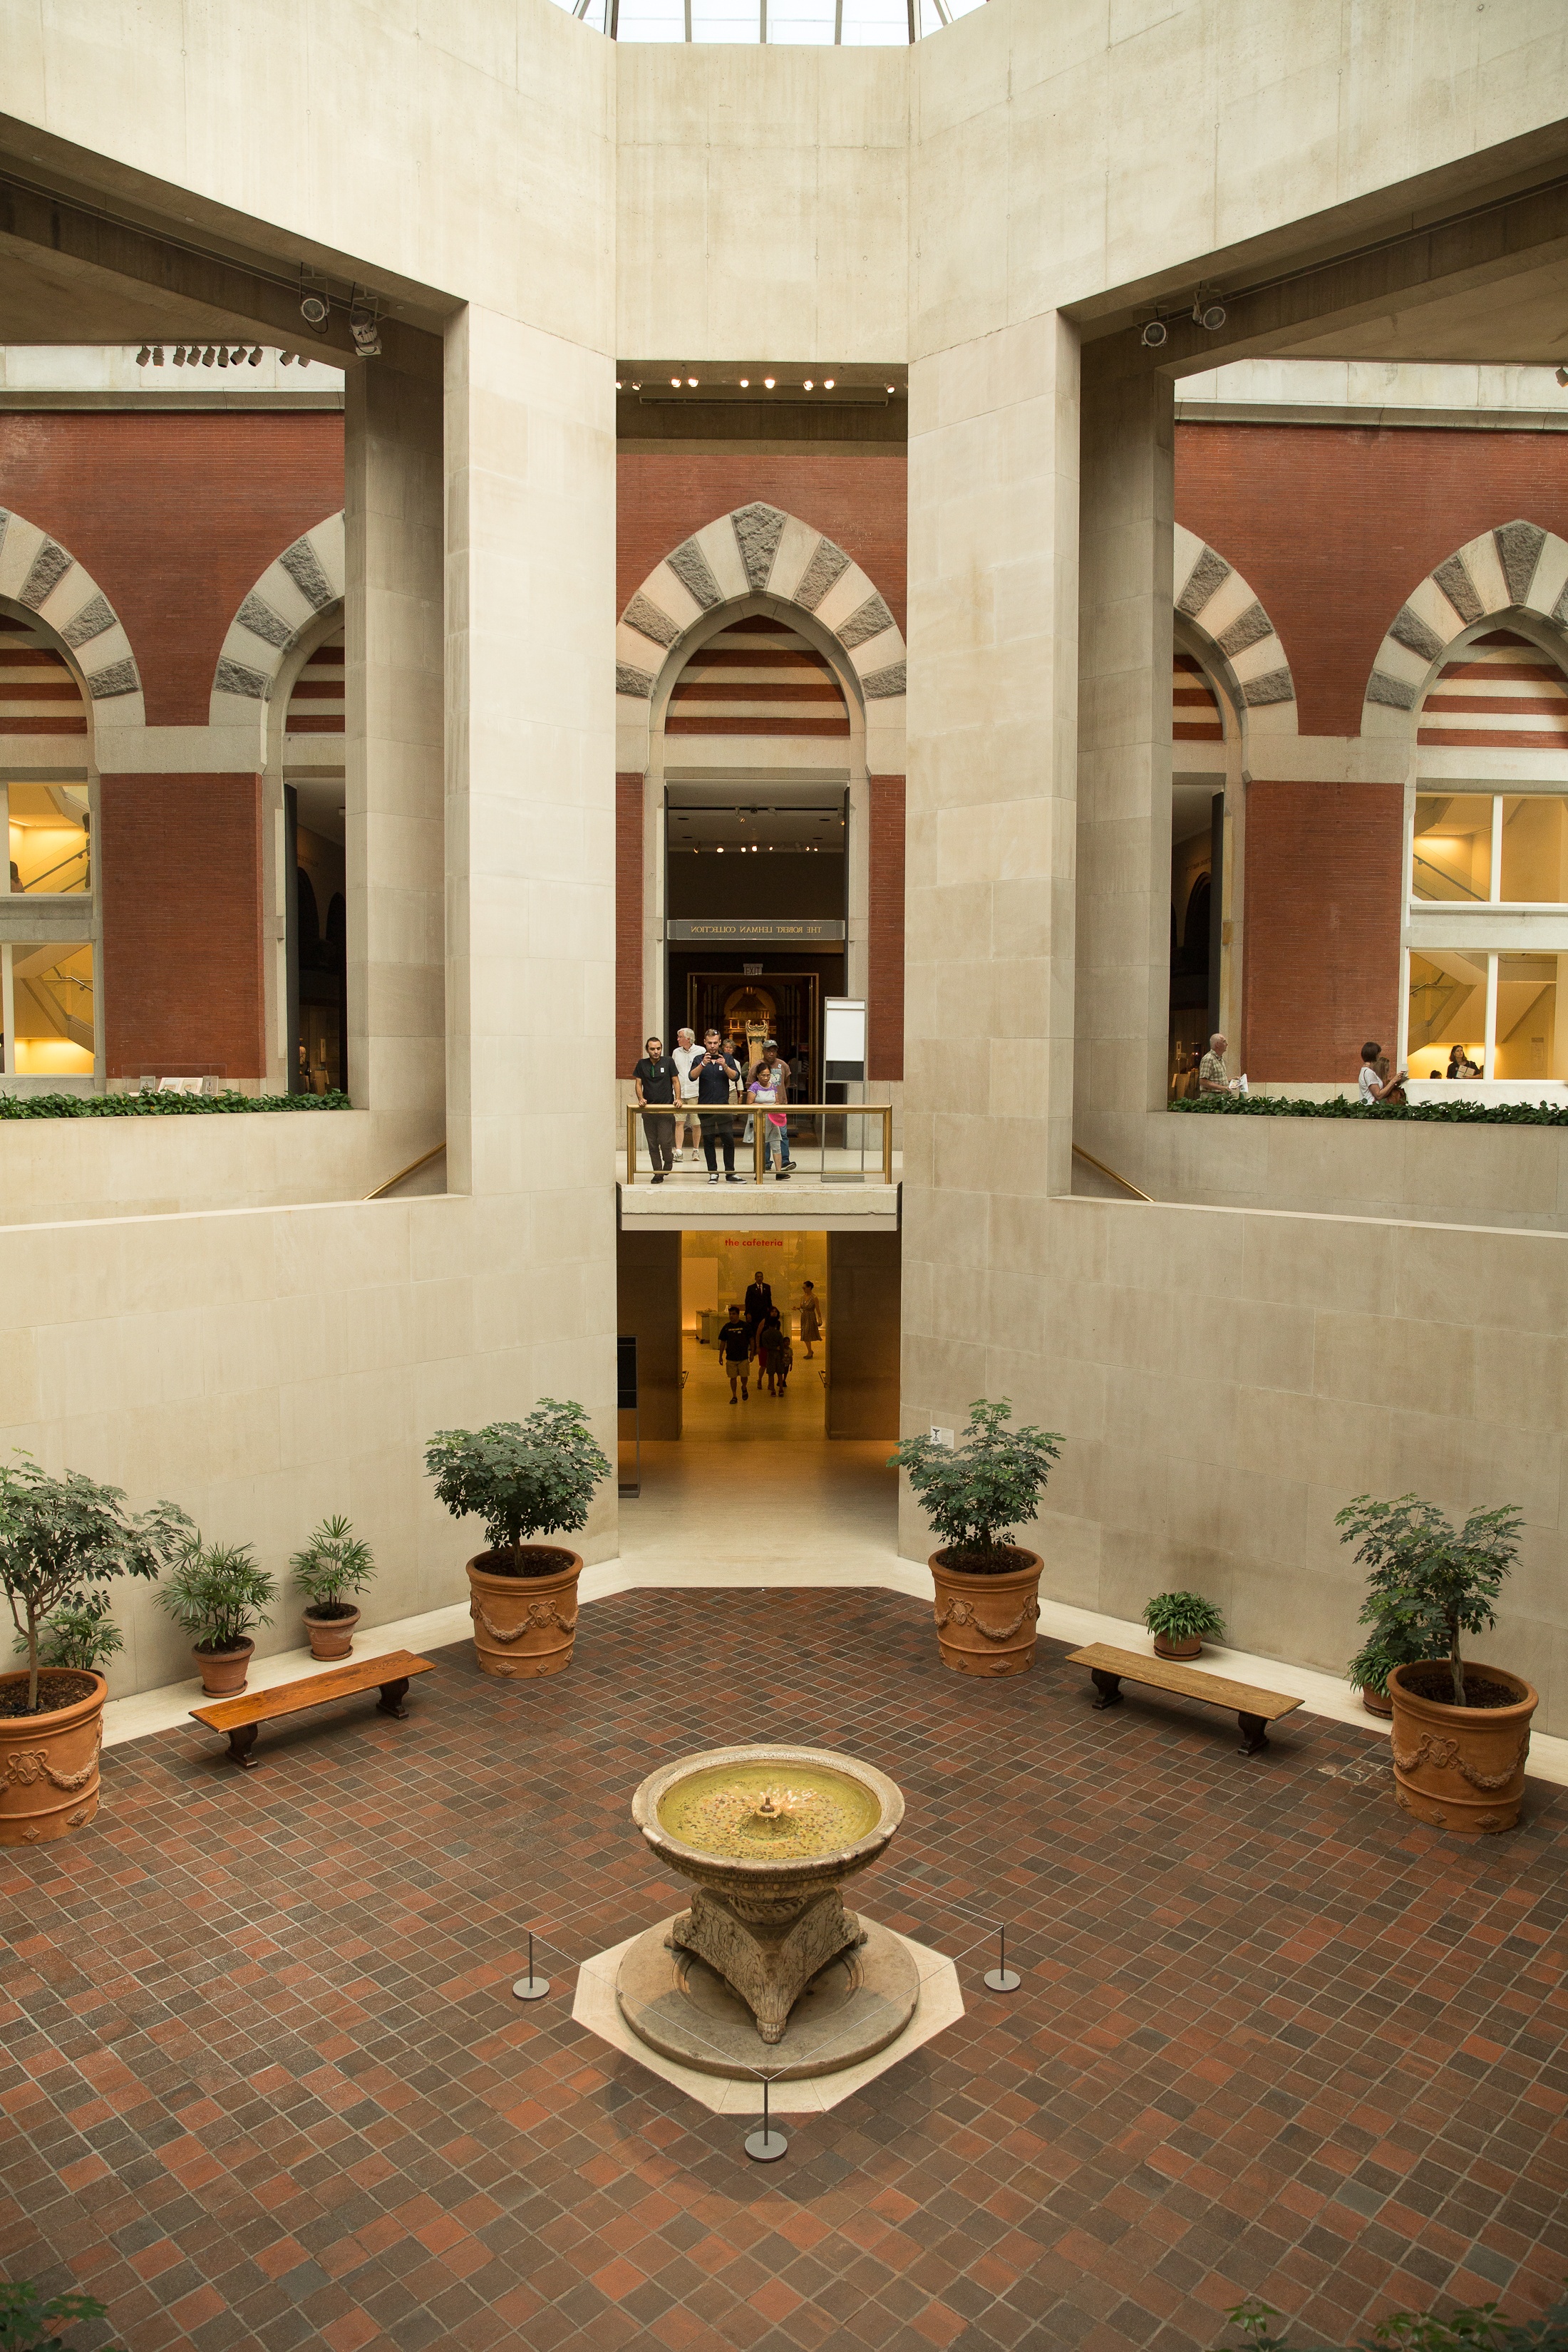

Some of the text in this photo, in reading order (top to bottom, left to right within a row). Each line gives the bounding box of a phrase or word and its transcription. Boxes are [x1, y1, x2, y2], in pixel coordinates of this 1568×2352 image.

[746, 966, 760, 975] EXIT
[725, 1238, 783, 1247] the cafeteria
